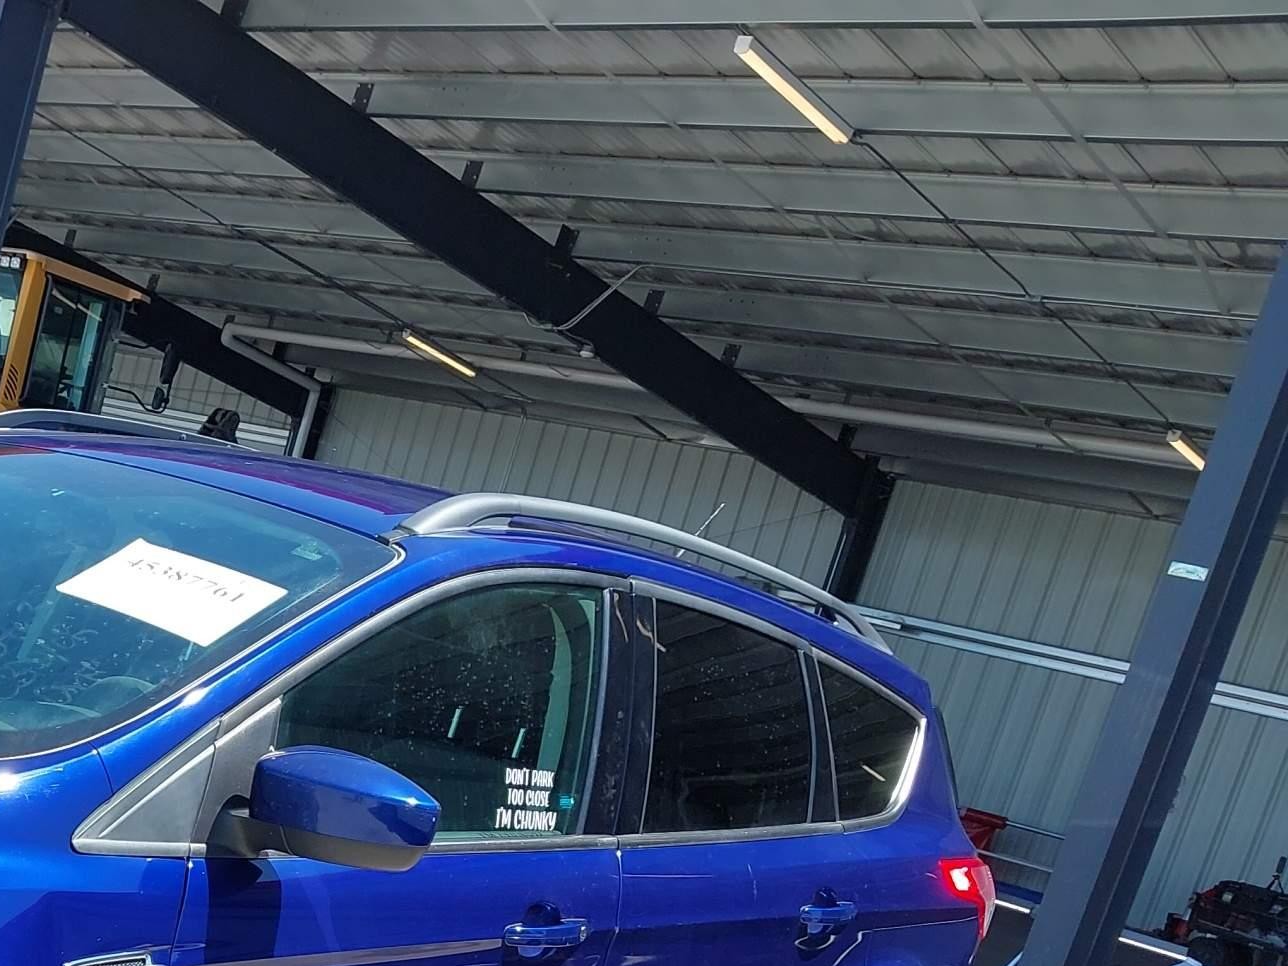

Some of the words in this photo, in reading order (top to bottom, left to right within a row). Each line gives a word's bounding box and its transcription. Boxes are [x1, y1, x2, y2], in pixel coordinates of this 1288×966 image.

[505, 767, 531, 786] DON'T
[531, 769, 555, 788] PARK
[507, 787, 524, 806] TOO
[525, 789, 551, 808] CLOSE
[494, 806, 512, 830] I'M
[513, 809, 558, 831] CHUNKY
